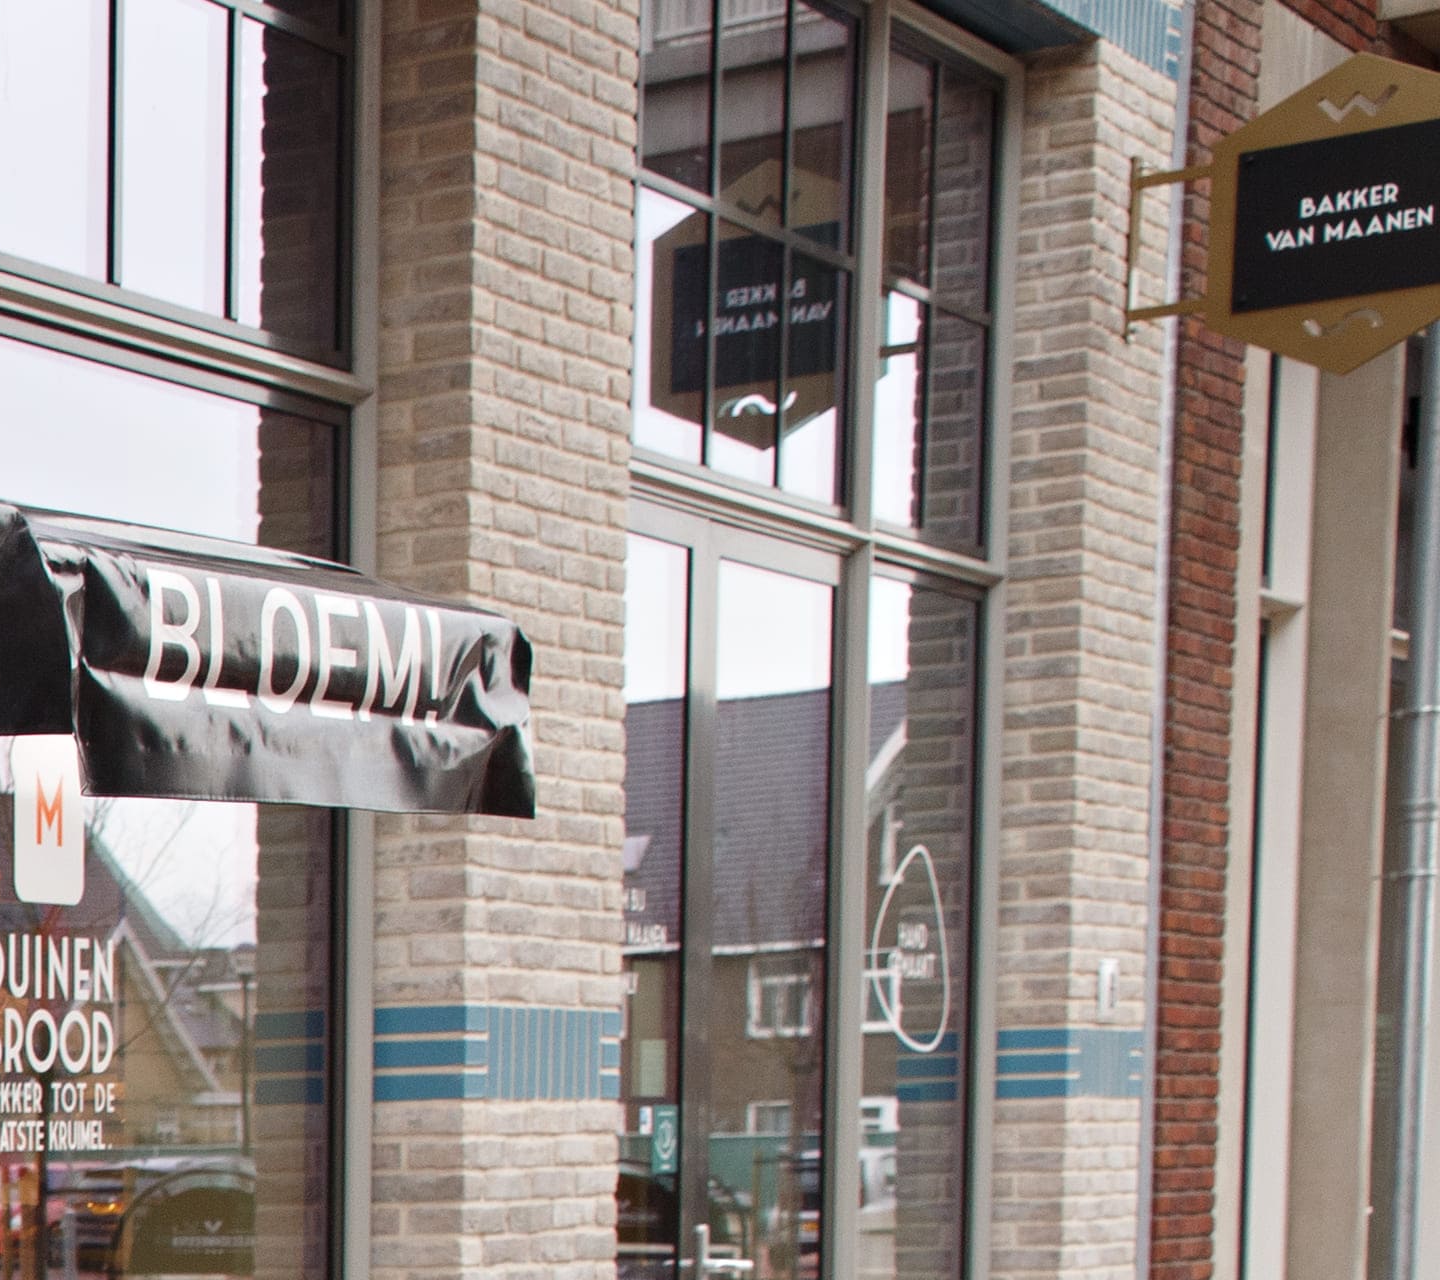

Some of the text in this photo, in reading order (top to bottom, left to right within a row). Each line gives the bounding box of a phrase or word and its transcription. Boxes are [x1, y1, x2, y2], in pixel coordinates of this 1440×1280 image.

[1298, 182, 1400, 219] BAKKER
[1264, 205, 1435, 252] VAN MAANEN
[143, 567, 444, 729] BLOEM!
[35, 768, 64, 848] M
[51, 1082, 87, 1114] TOT
[94, 1082, 116, 1114] DE
